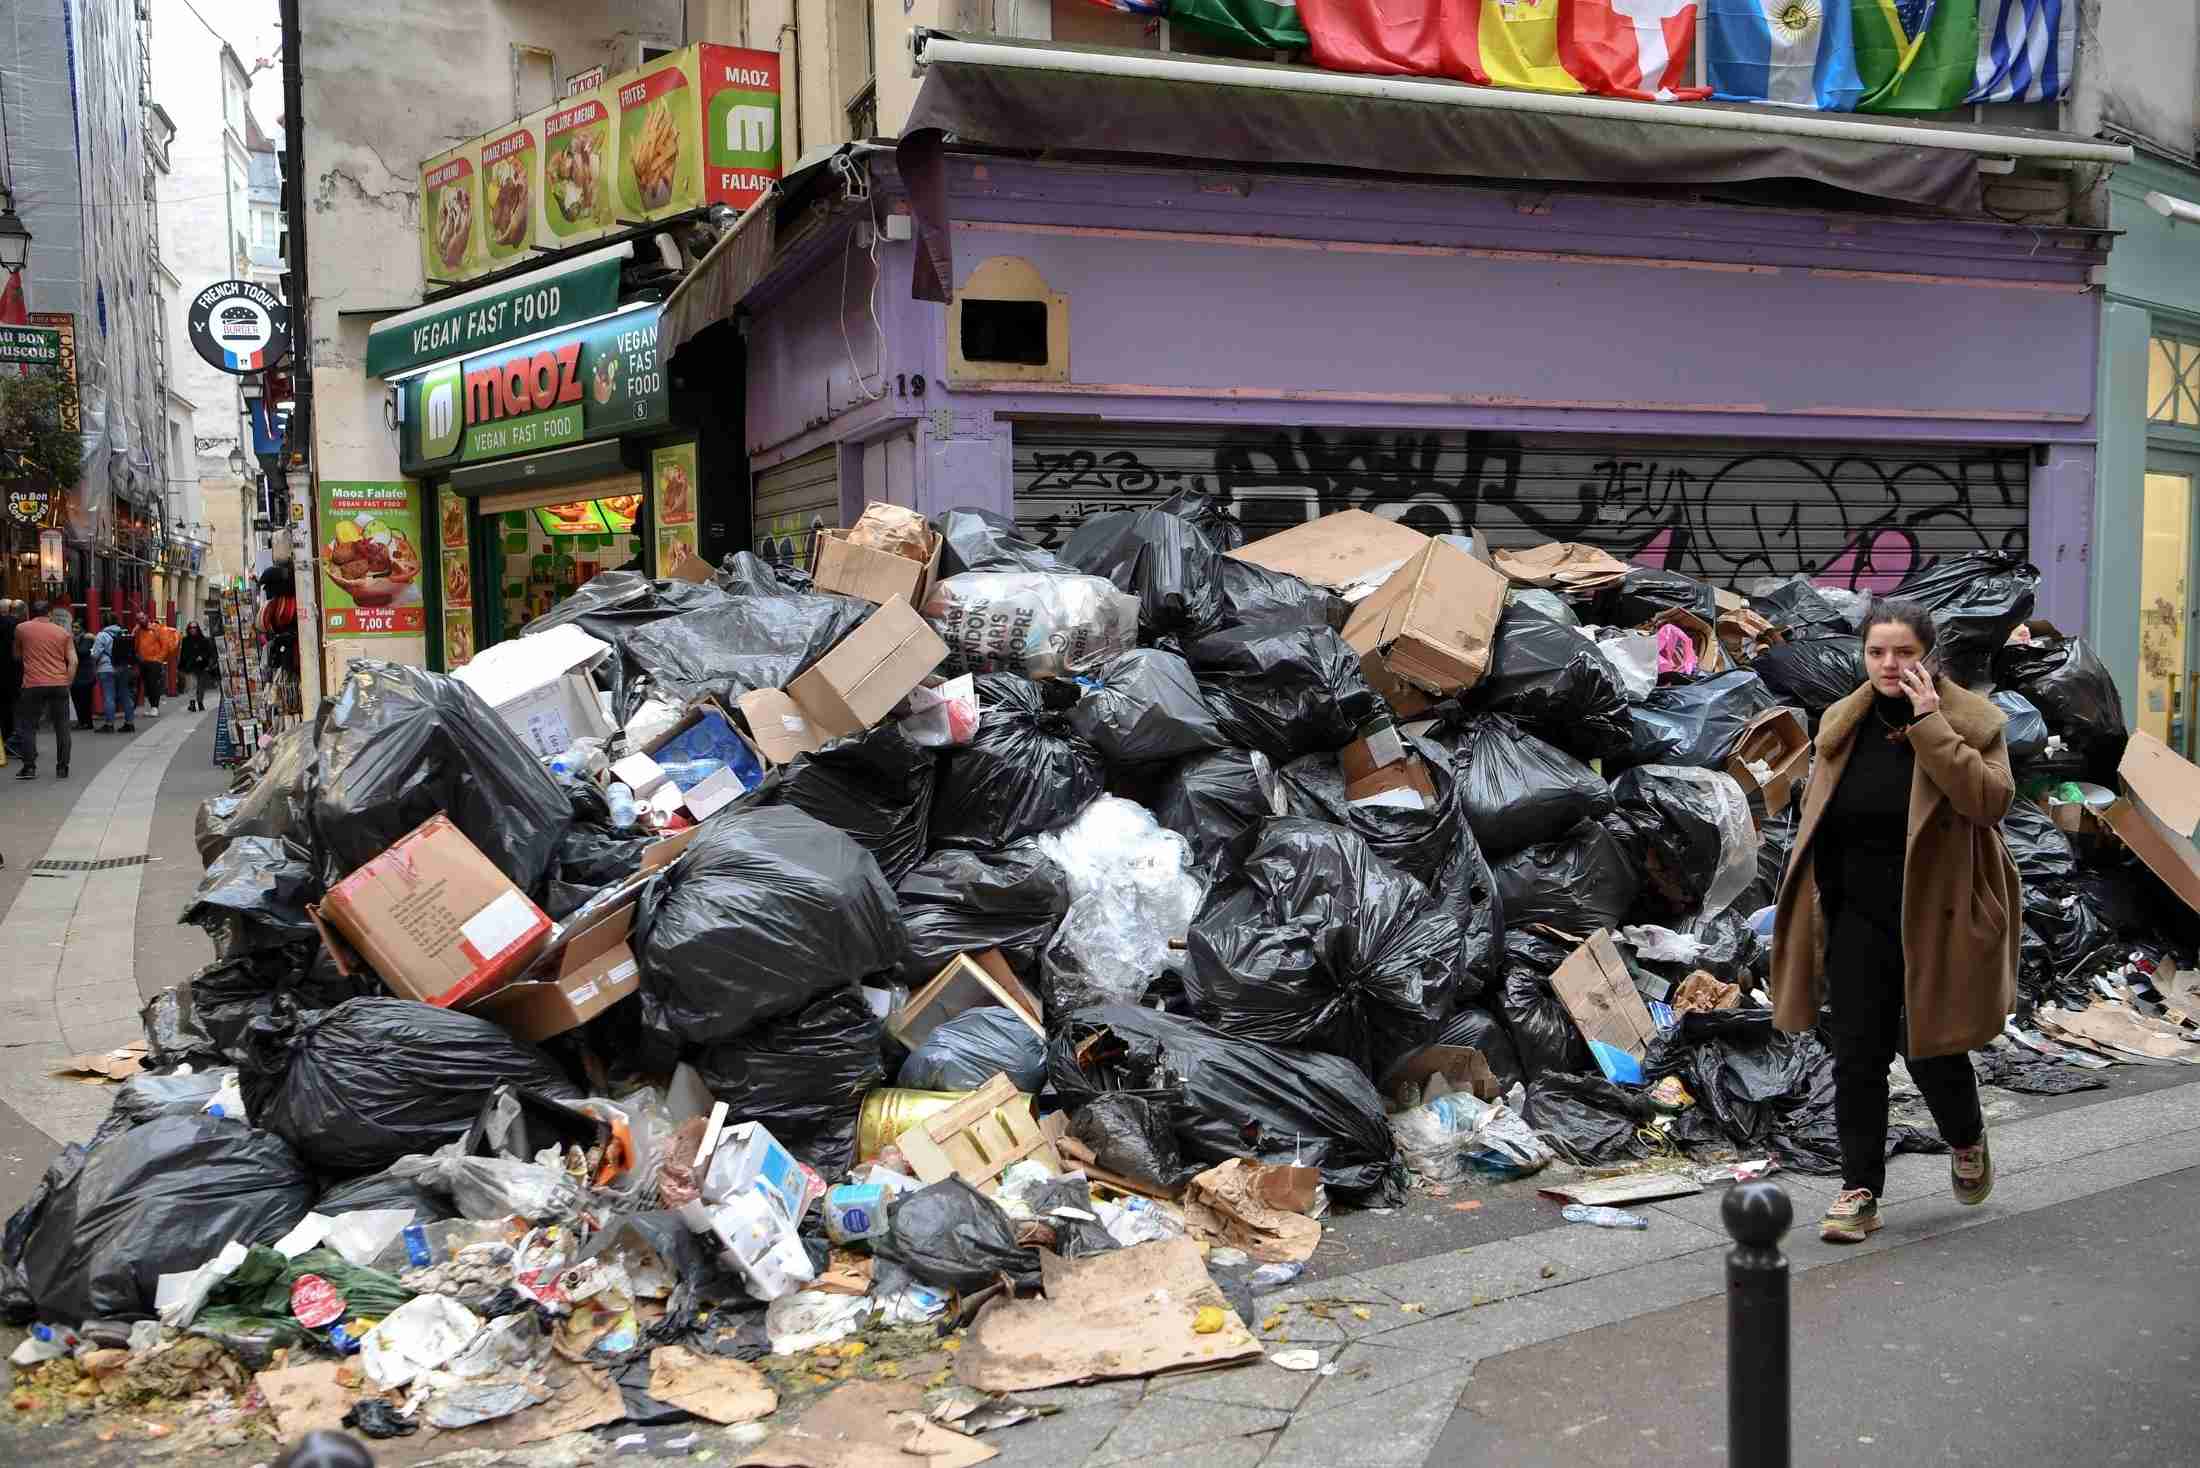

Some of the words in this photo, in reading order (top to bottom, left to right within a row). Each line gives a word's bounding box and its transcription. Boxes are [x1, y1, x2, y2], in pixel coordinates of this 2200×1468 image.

[725, 65, 770, 87] MAOZ
[621, 82, 647, 107] FRITES
[546, 116, 573, 136] SALADE
[573, 103, 596, 125] MENU
[198, 282, 239, 309] FRENCH
[414, 315, 462, 355] VEGAN
[467, 301, 508, 340] FAST
[514, 287, 561, 327] FOOD
[18, 332, 45, 345] BON
[616, 326, 658, 353] VEGAN
[464, 342, 584, 425] maoz
[627, 372, 660, 399] FOOD
[896, 373, 926, 398] 19
[474, 431, 507, 451] VEGAN
[512, 424, 537, 444] FAST
[544, 417, 571, 438] FOOD
[332, 488, 364, 498] Maoz
[367, 488, 407, 498] Falafel
[359, 617, 383, 631] 7,00
[385, 617, 393, 629] €
[986, 613, 1009, 662] PARIS
[1008, 607, 1034, 672] PROPRE
